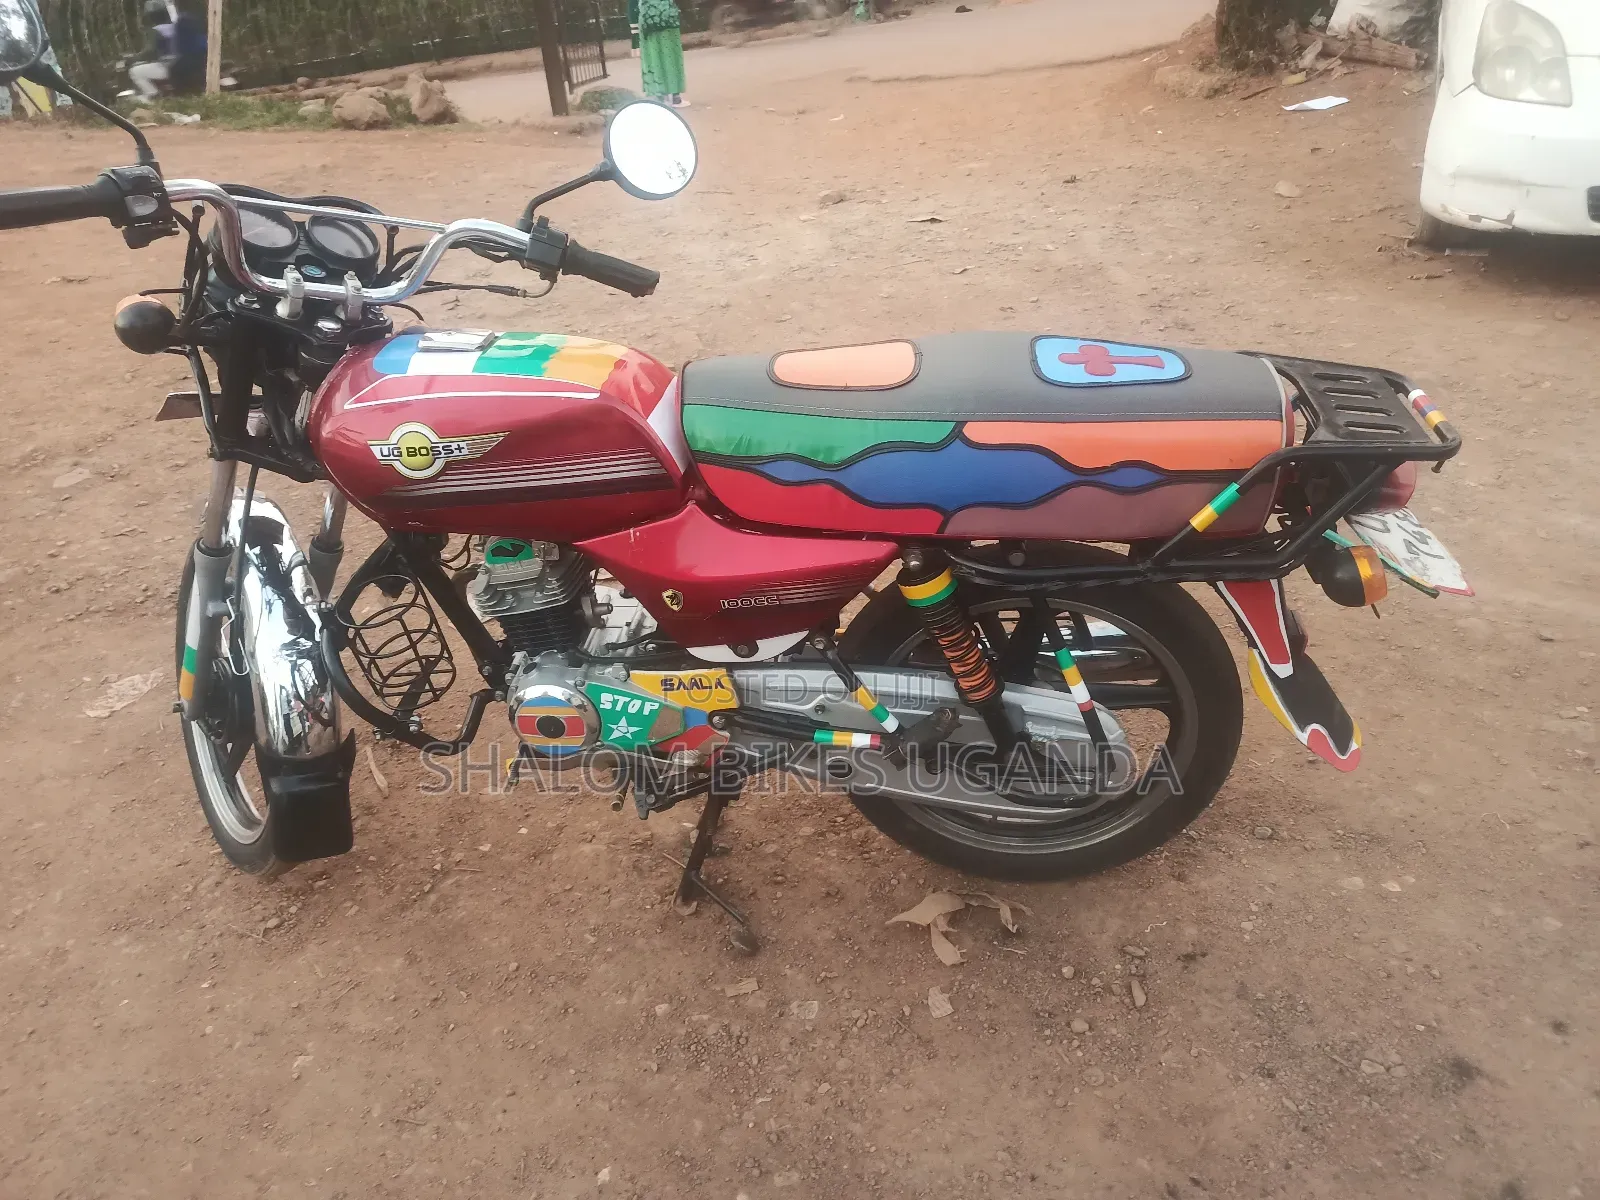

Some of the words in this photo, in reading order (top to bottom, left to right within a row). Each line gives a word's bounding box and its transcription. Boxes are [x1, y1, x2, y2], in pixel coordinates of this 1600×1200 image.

[379, 446, 403, 458] UG
[405, 444, 466, 458] BOSS+
[720, 595, 780, 610] 100CC
[600, 692, 660, 716] STOP
